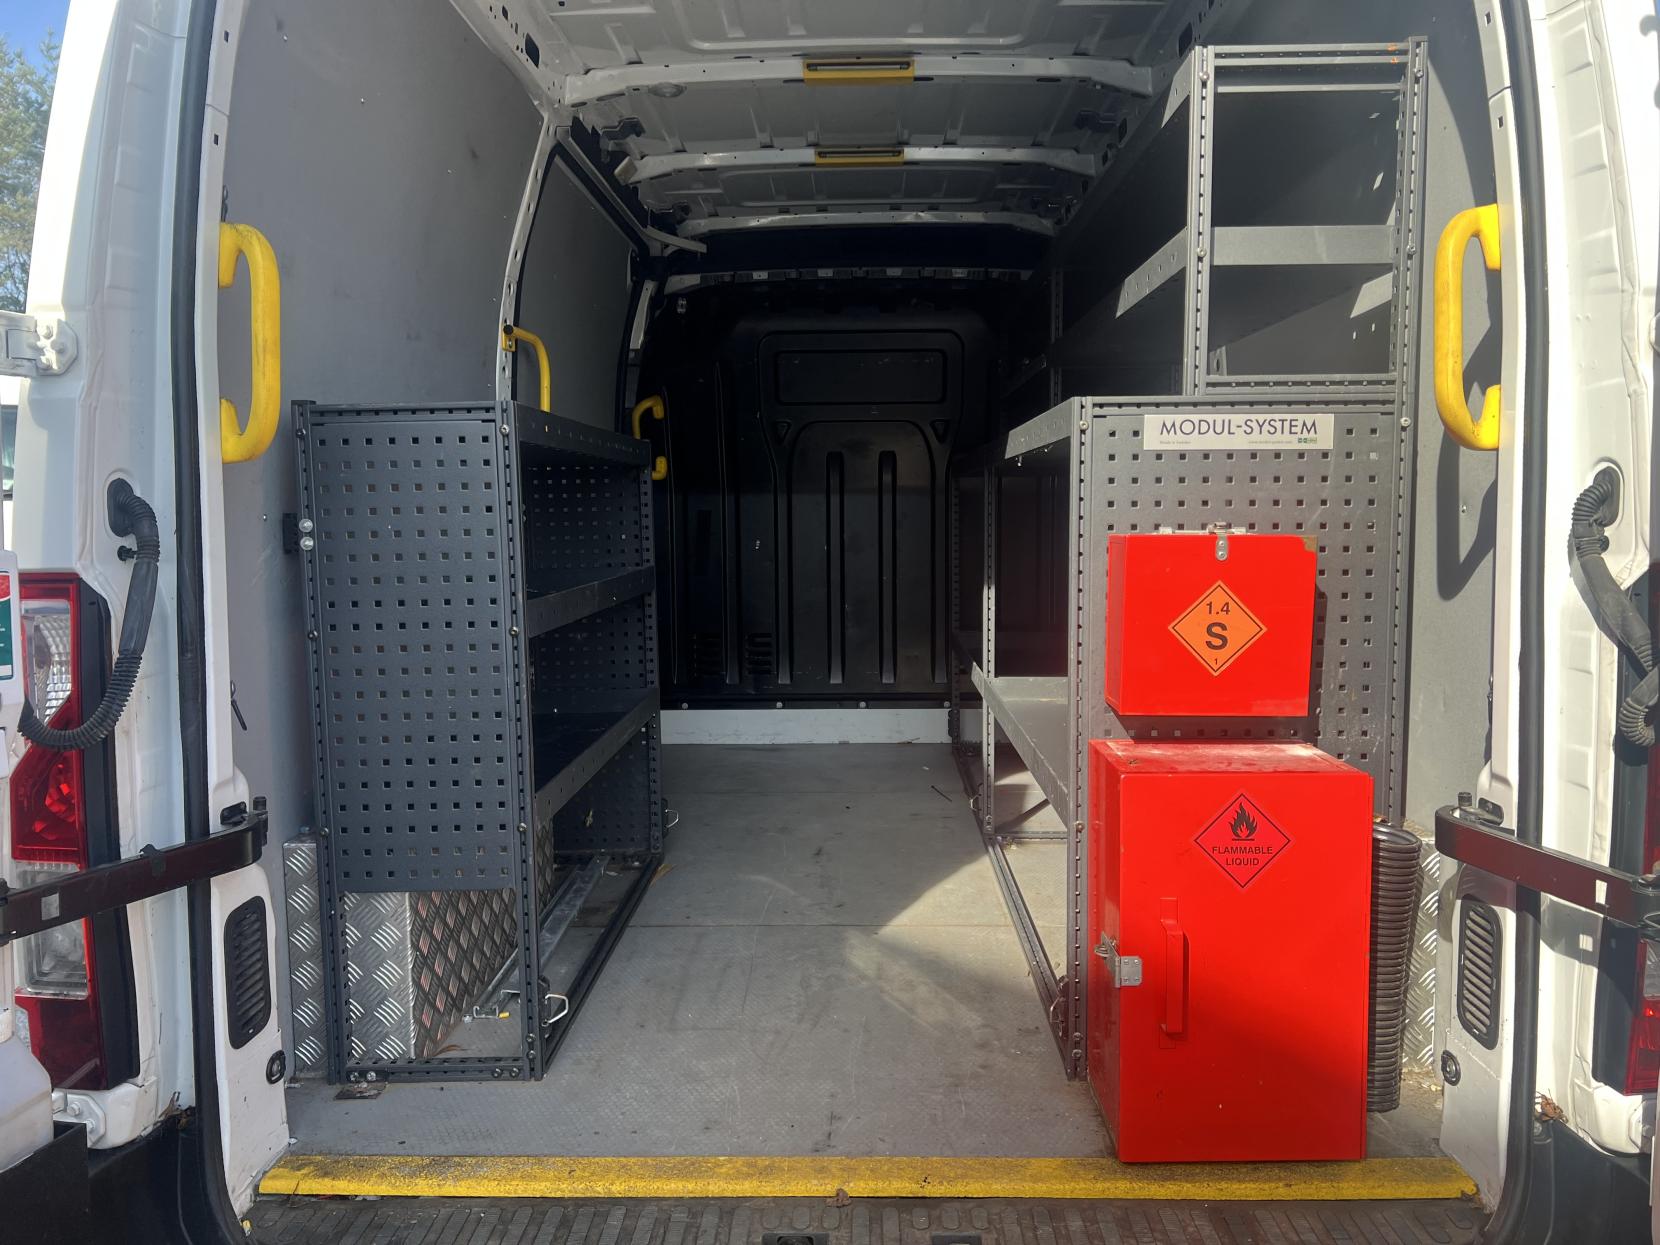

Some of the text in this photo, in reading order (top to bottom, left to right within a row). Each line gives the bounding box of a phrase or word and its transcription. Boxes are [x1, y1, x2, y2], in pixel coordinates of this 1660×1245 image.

[1160, 418, 1318, 436] MODUL-SYSTEM
[1206, 601, 1231, 615] 1.4
[1205, 621, 1229, 651] S
[1213, 657, 1219, 666] 1
[1212, 846, 1273, 855] FLAMMABLE
[1225, 857, 1260, 866] LIQUID
